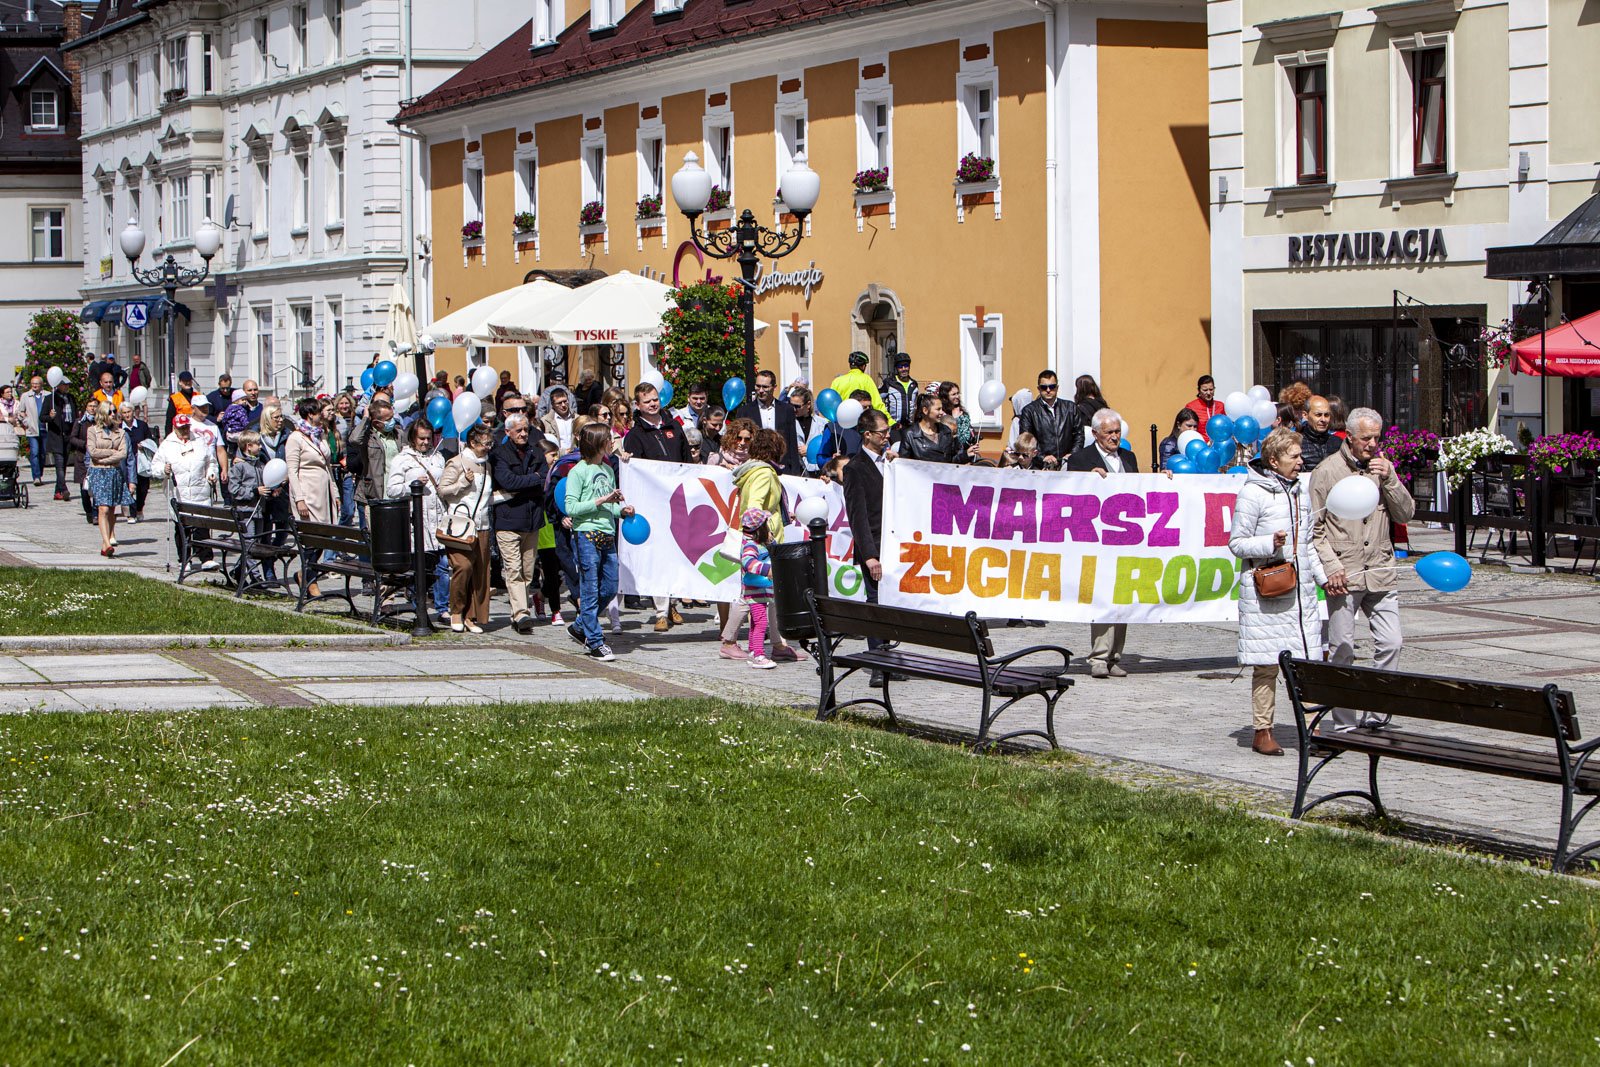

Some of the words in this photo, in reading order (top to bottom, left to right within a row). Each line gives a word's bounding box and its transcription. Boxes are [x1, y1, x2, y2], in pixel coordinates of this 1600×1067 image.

[1288, 229, 1447, 262] RESTAURACJA
[574, 329, 618, 341] TYSKIE
[931, 483, 1180, 548] MARSZ
[898, 531, 1062, 602] ŻYCIA
[1077, 555, 1098, 605] I
